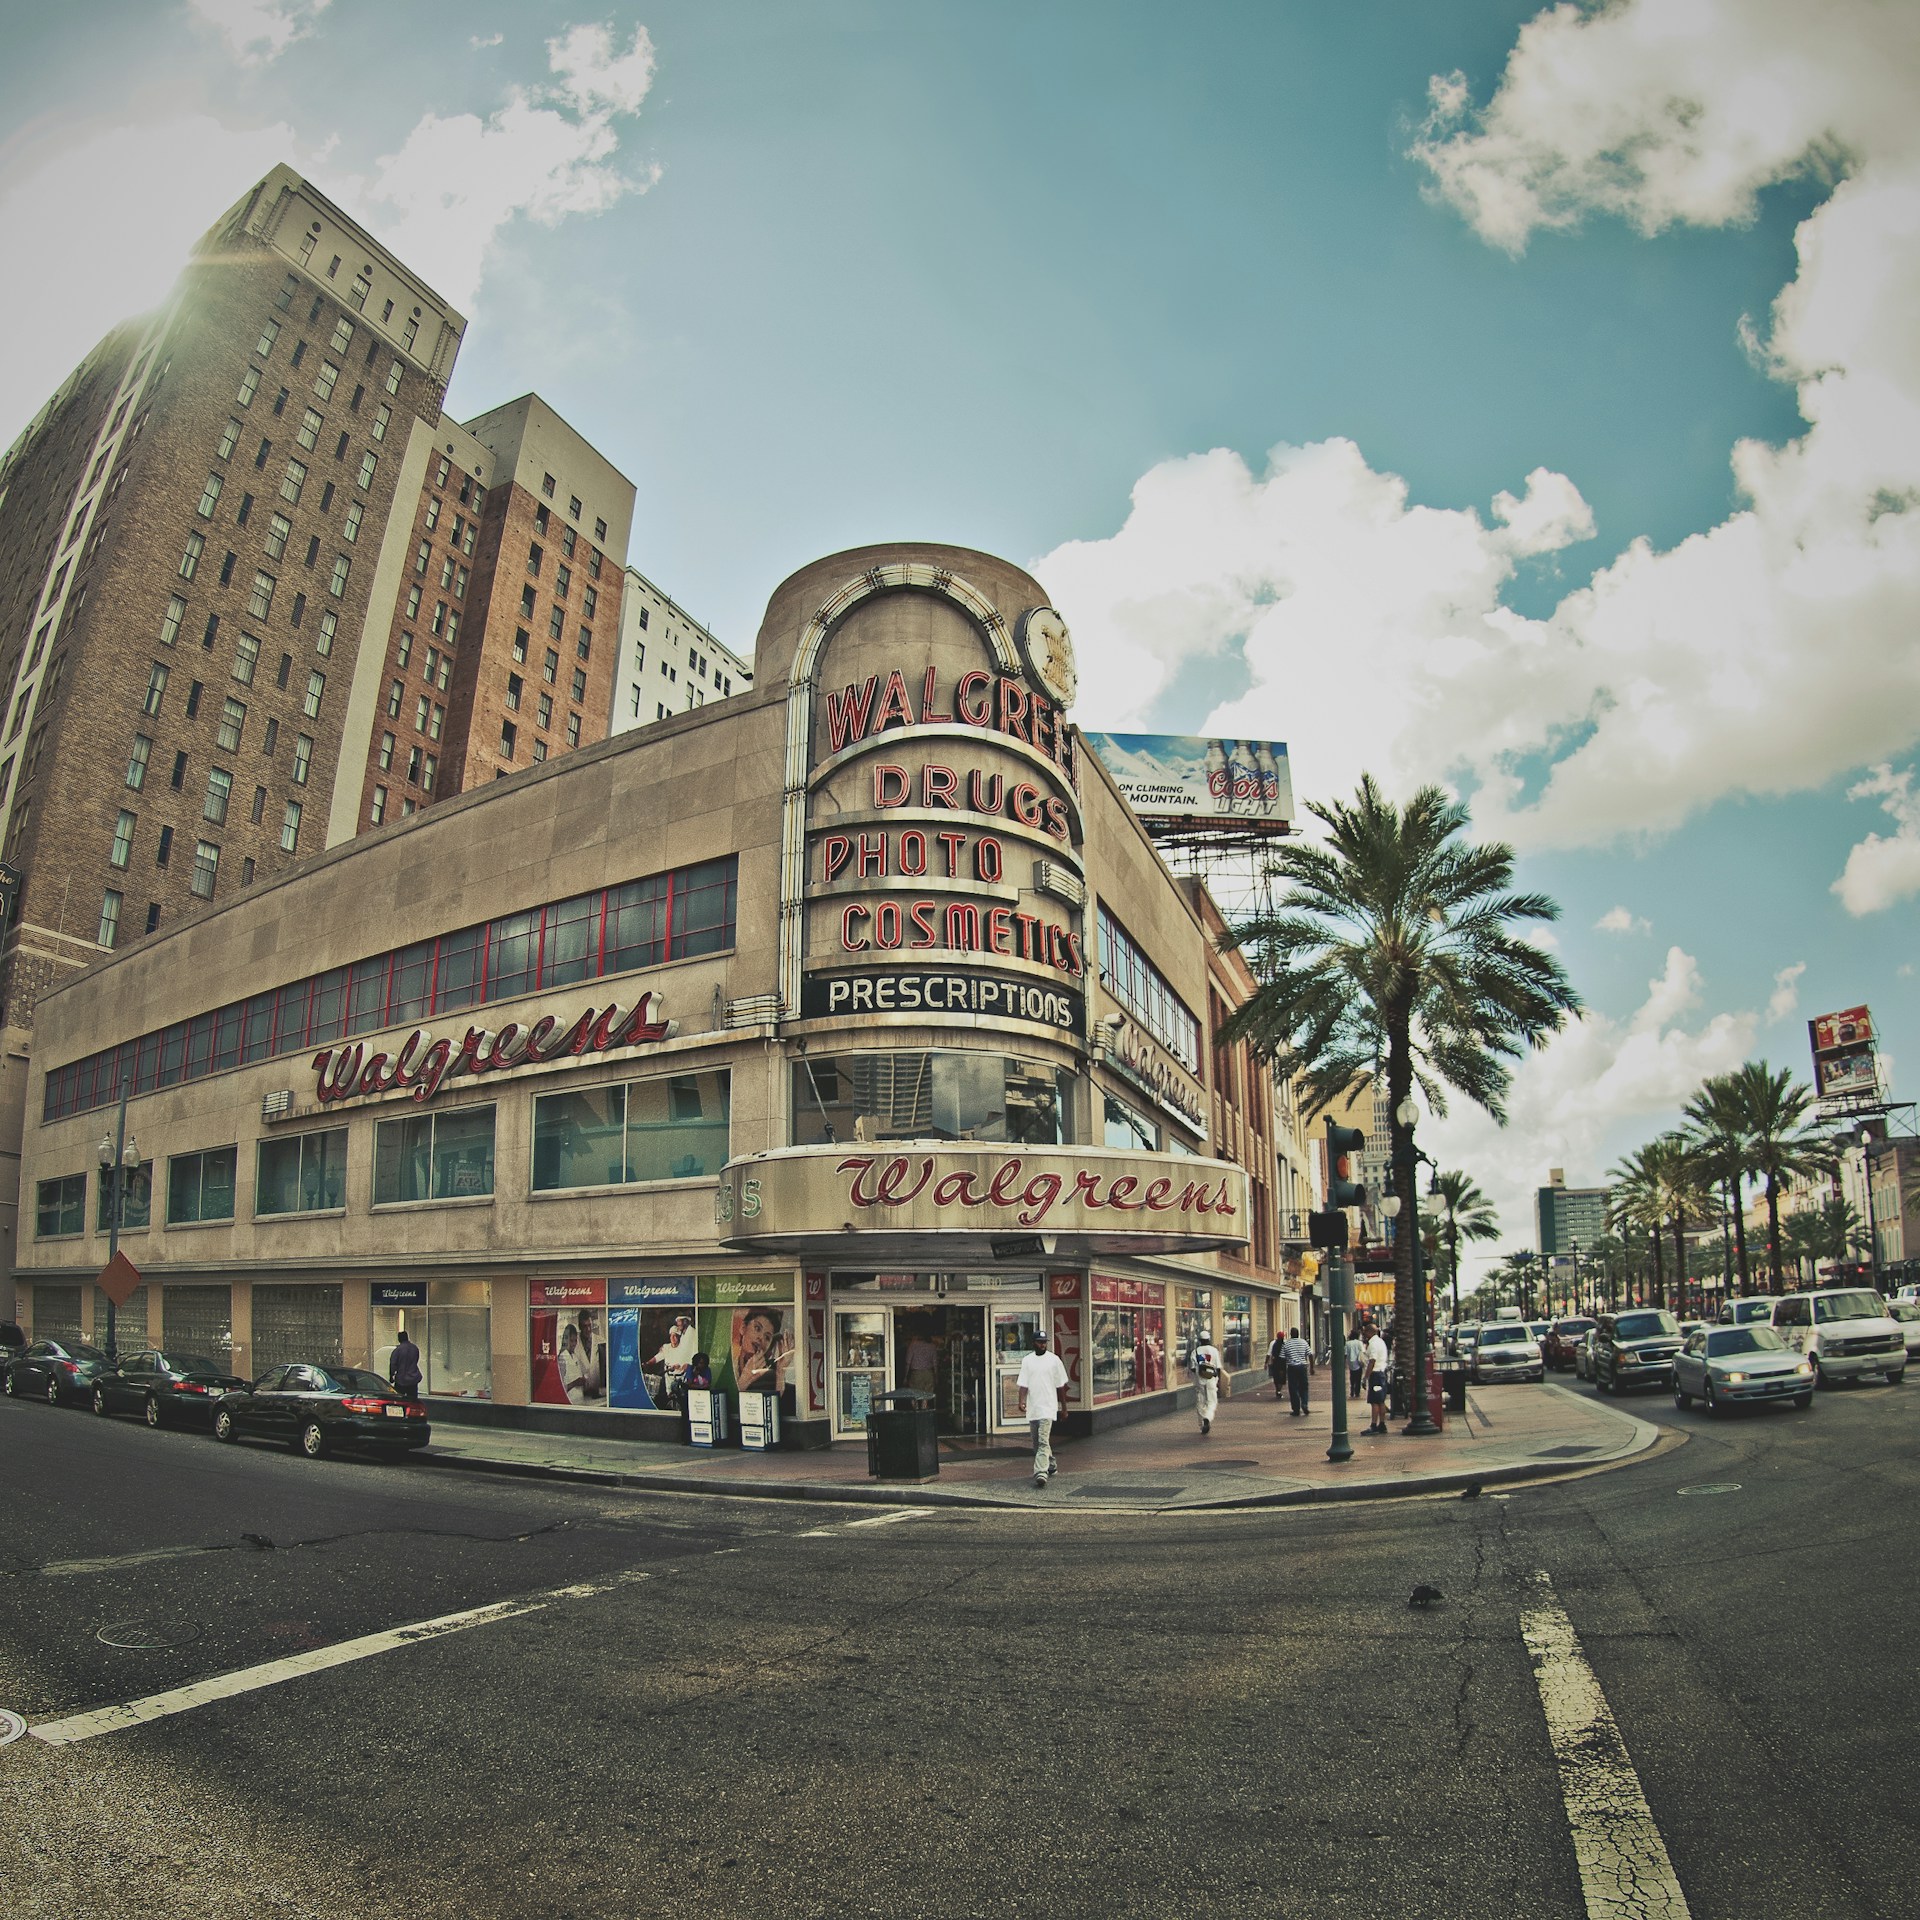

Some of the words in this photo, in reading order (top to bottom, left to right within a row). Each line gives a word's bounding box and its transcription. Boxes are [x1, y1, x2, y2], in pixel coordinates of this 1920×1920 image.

[826, 666, 1081, 802] WALGREE
[874, 764, 1068, 841] DRUGS
[1130, 794, 1198, 805] MOUNTAIN.
[1136, 784, 1184, 794] CLIMBING
[1207, 769, 1278, 799] Coors
[1214, 798, 1277, 816] LIGHT
[824, 830, 1002, 883] PHOTO
[841, 900, 1084, 978] COSMETICS
[829, 977, 1073, 1027] PRESCRIPTIONS
[311, 991, 679, 1102] Walgreens
[836, 1156, 1237, 1227] Walgreens
[544, 1286, 592, 1298] Walgreens
[623, 1285, 679, 1298] Walgreens
[716, 1282, 776, 1297] Walgreens
